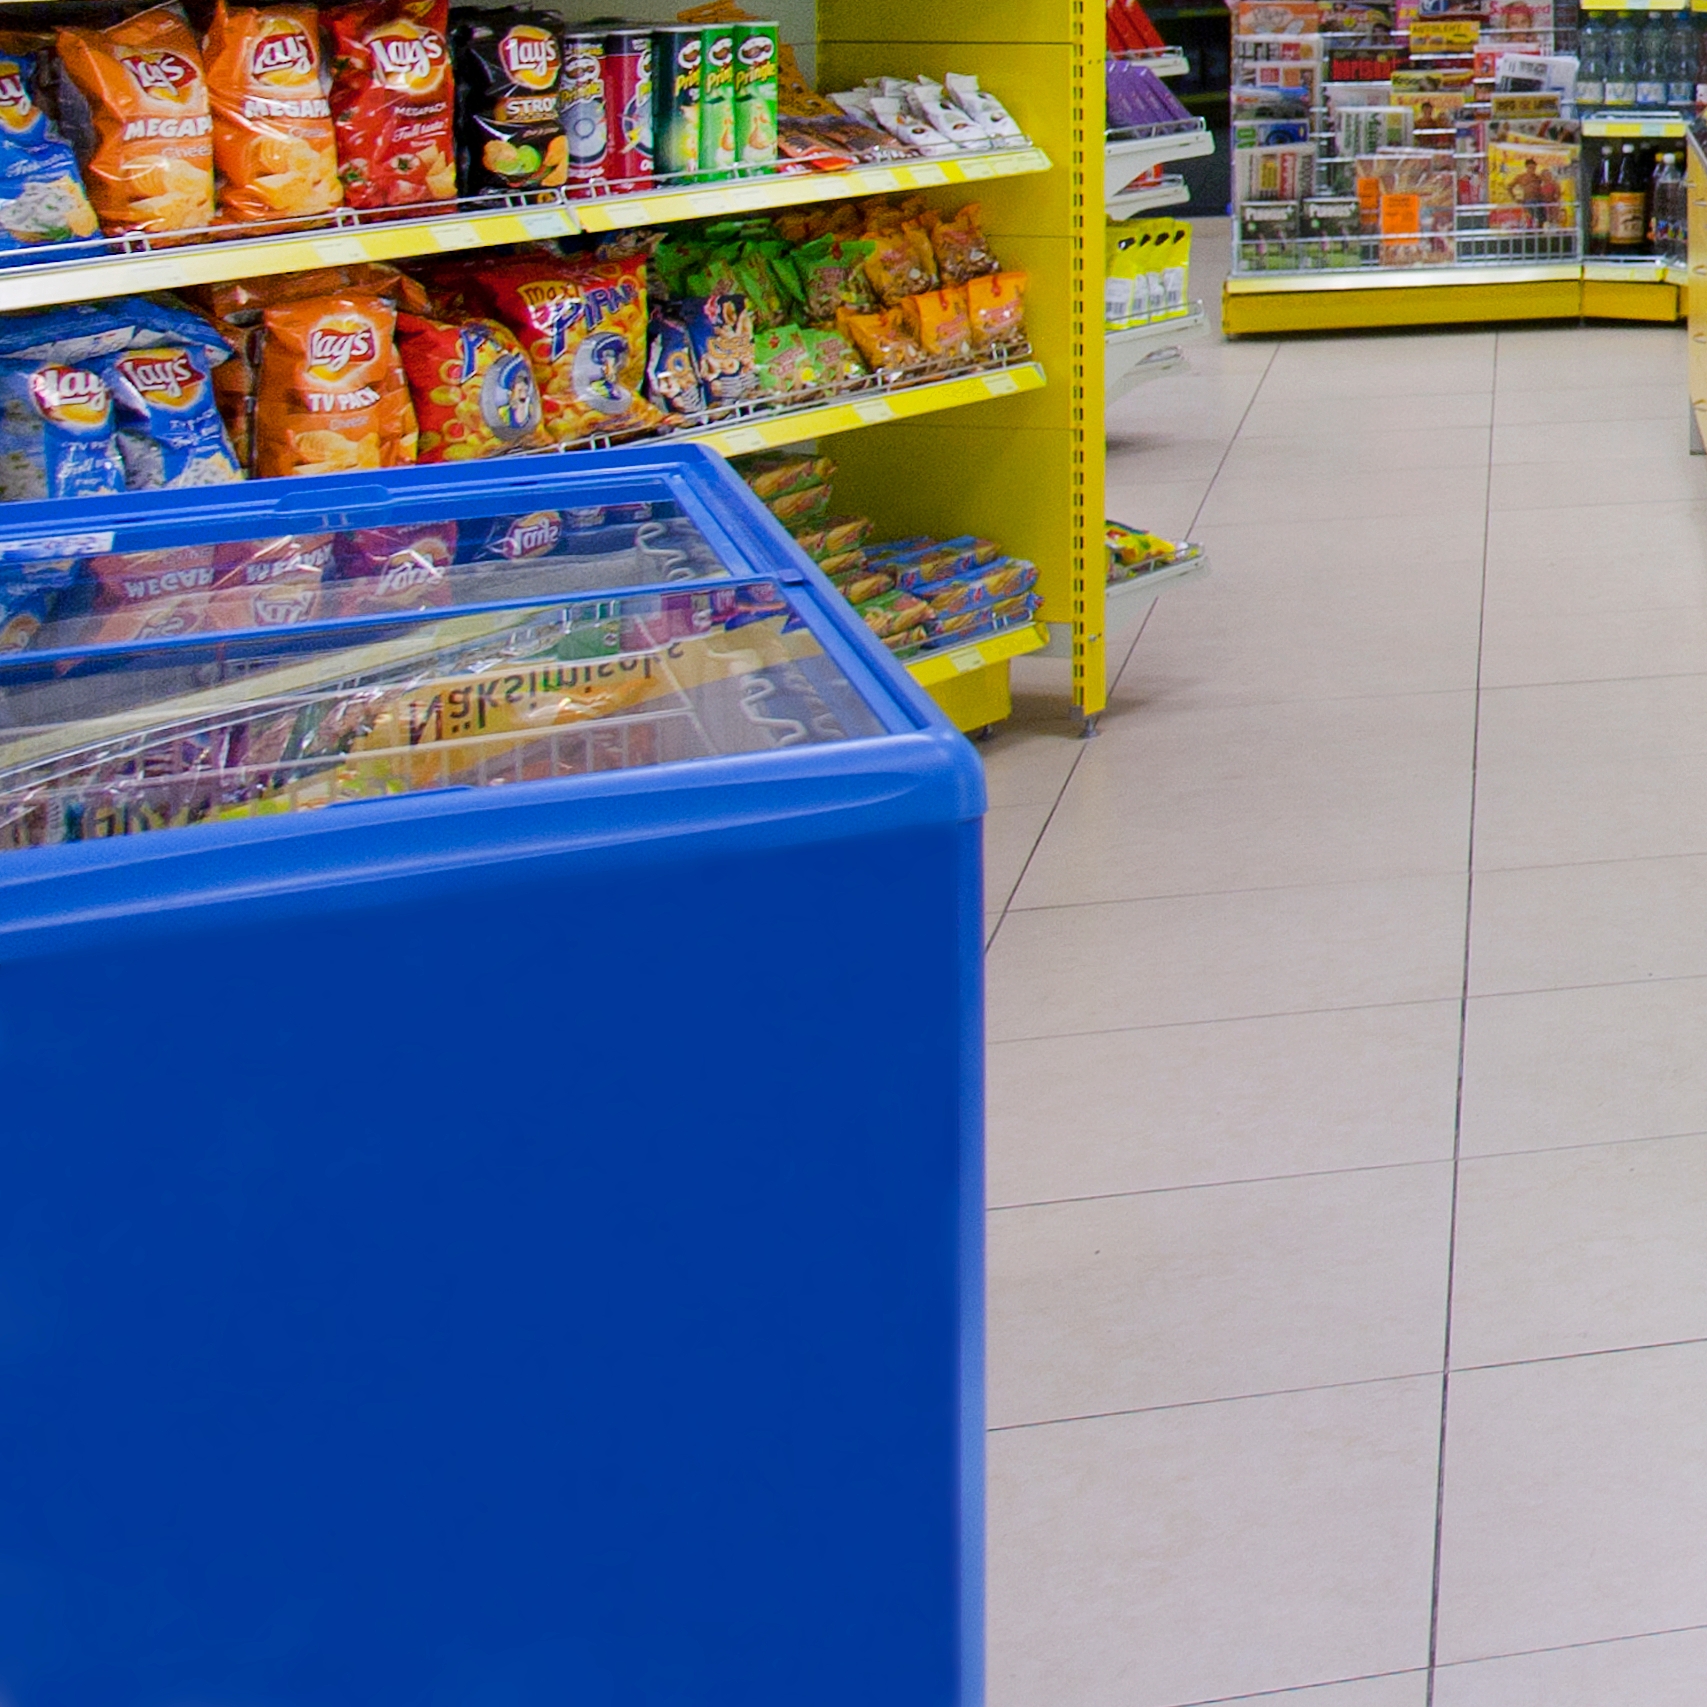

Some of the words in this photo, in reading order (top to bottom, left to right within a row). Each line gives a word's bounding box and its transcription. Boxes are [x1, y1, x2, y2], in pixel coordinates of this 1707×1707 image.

[369, 33, 443, 79] Lay's
[124, 358, 192, 398] Lay's
[308, 393, 335, 412] TV
